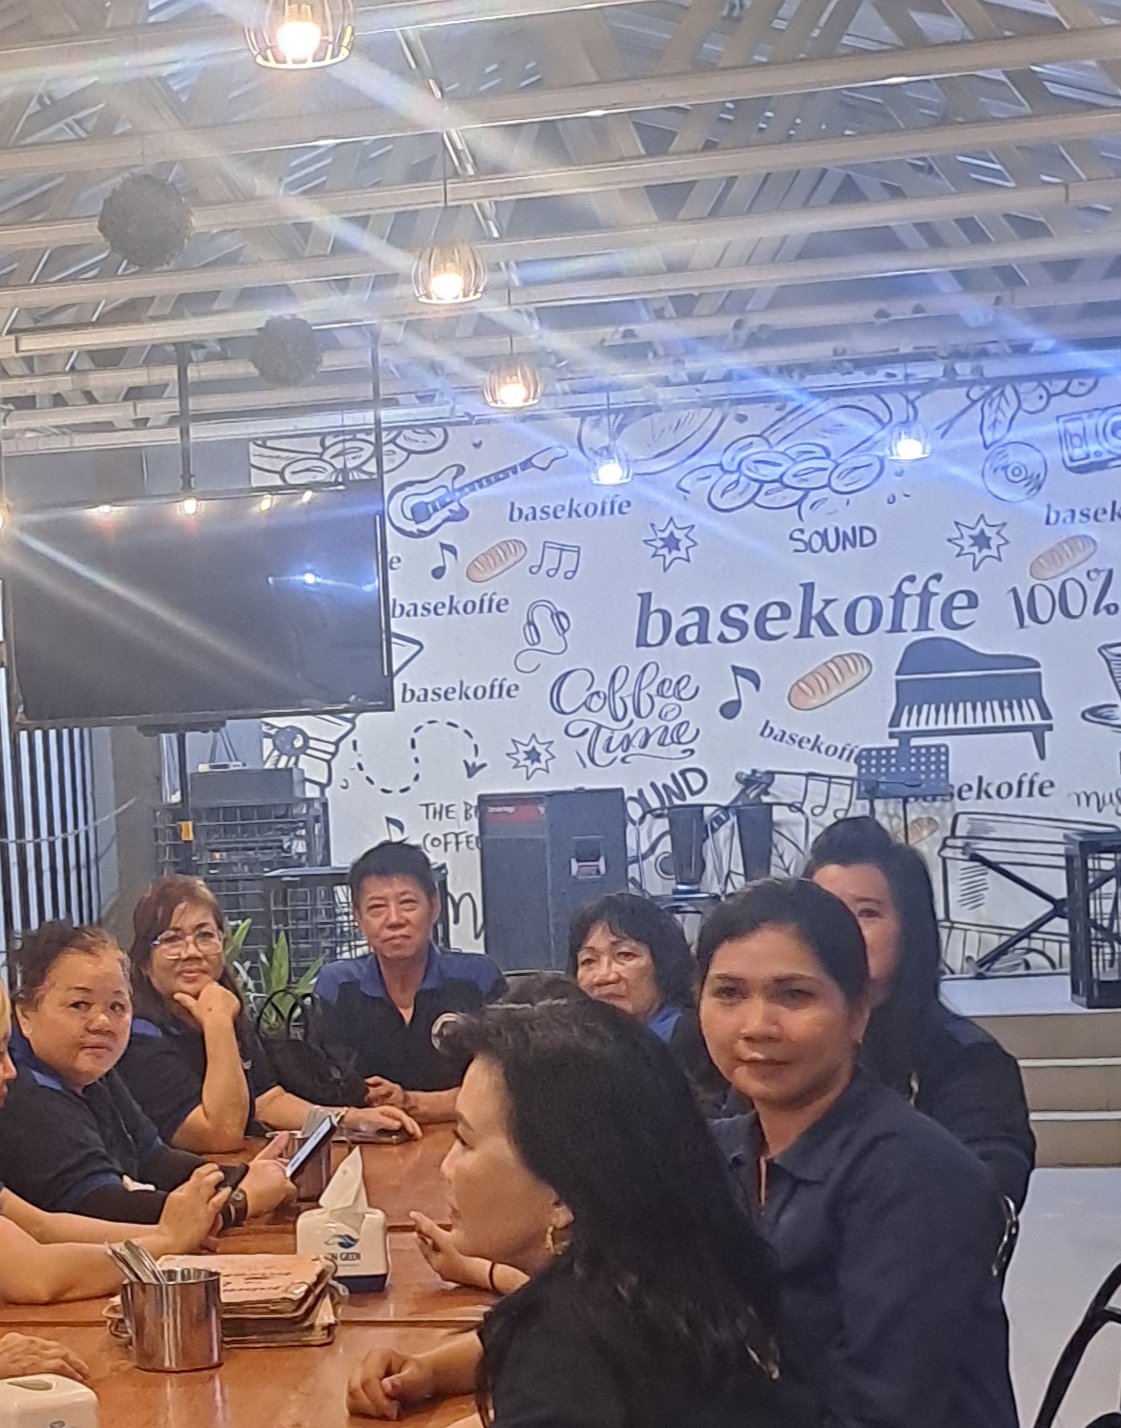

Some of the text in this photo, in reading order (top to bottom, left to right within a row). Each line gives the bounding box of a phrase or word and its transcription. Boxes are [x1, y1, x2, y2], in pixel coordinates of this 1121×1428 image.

[509, 494, 632, 522] basekoffe
[789, 525, 877, 553] SOUND
[391, 592, 509, 618] basekoffe
[635, 573, 979, 648] basekoffe
[1006, 568, 1120, 629] 100%
[401, 678, 520, 703] basekoffe
[549, 661, 699, 722] Coffee
[564, 718, 700, 767] Time
[759, 719, 859, 763] basekoff
[418, 802, 456, 821] THE
